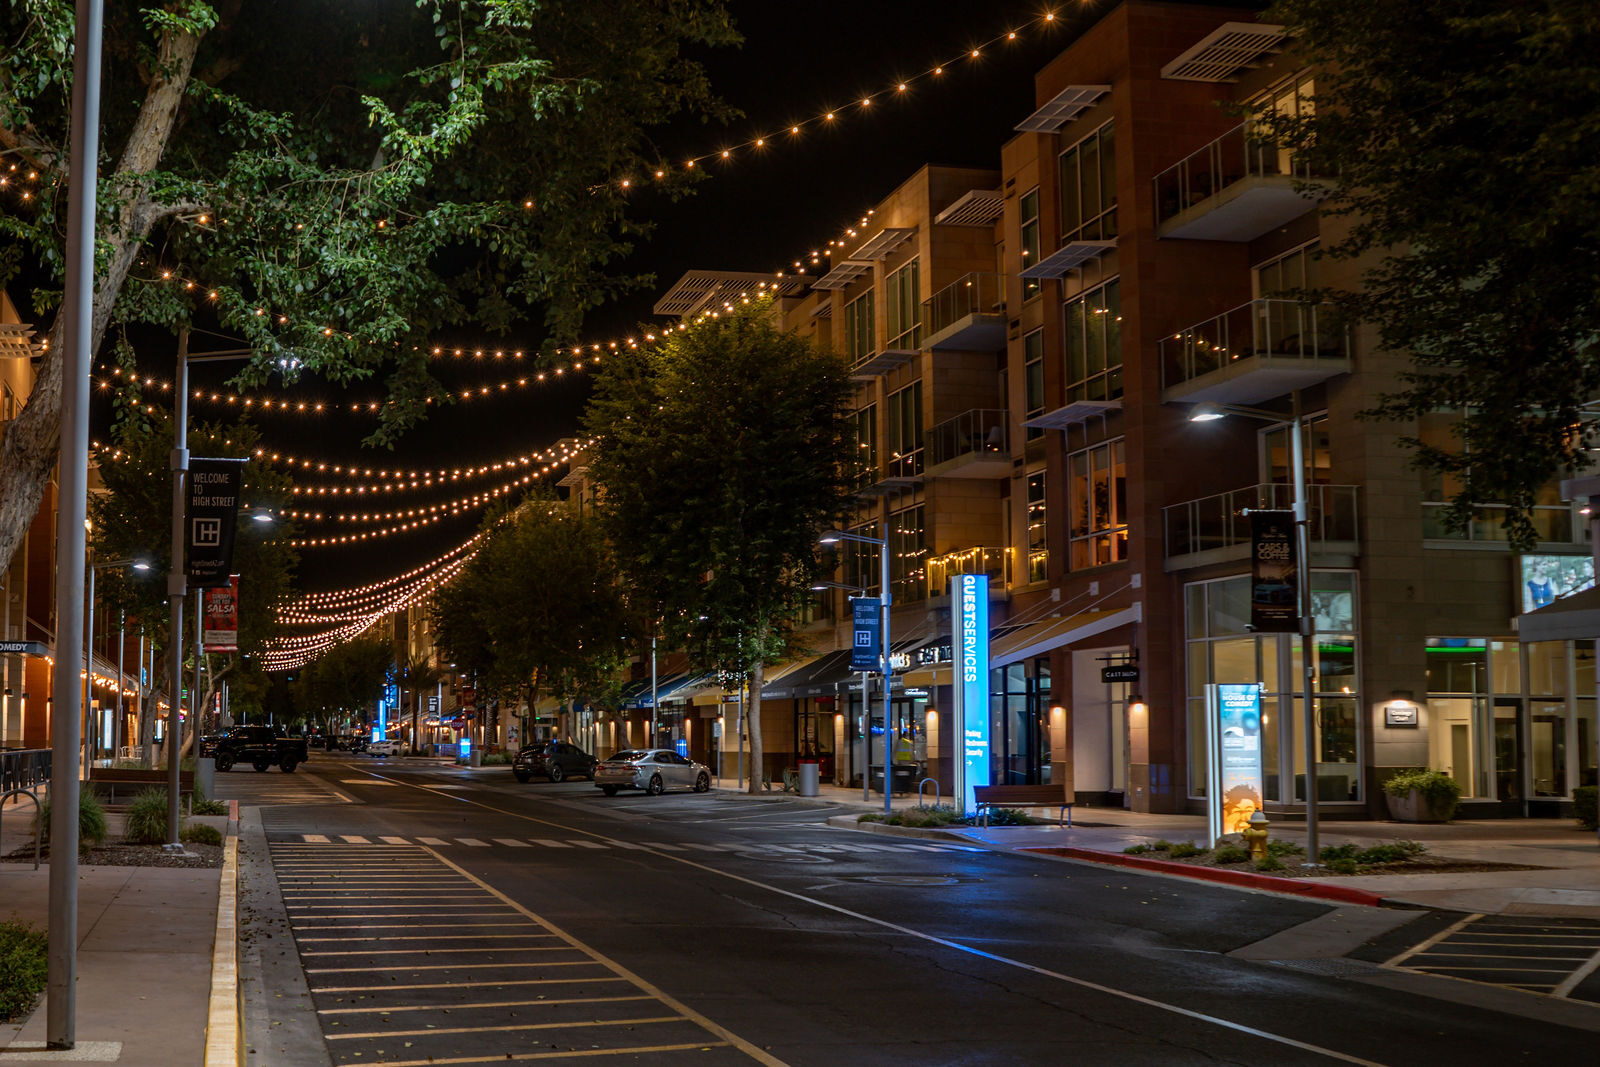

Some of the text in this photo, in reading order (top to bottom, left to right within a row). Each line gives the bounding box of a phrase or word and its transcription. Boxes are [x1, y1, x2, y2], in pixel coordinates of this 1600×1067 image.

[193, 473, 230, 483] WELCOME
[193, 484, 203, 495] TO
[193, 496, 235, 507] HIGH STREET
[1257, 542, 1281, 552] CARS
[1257, 551, 1290, 560] COFFEE
[207, 604, 235, 613] SALSA
